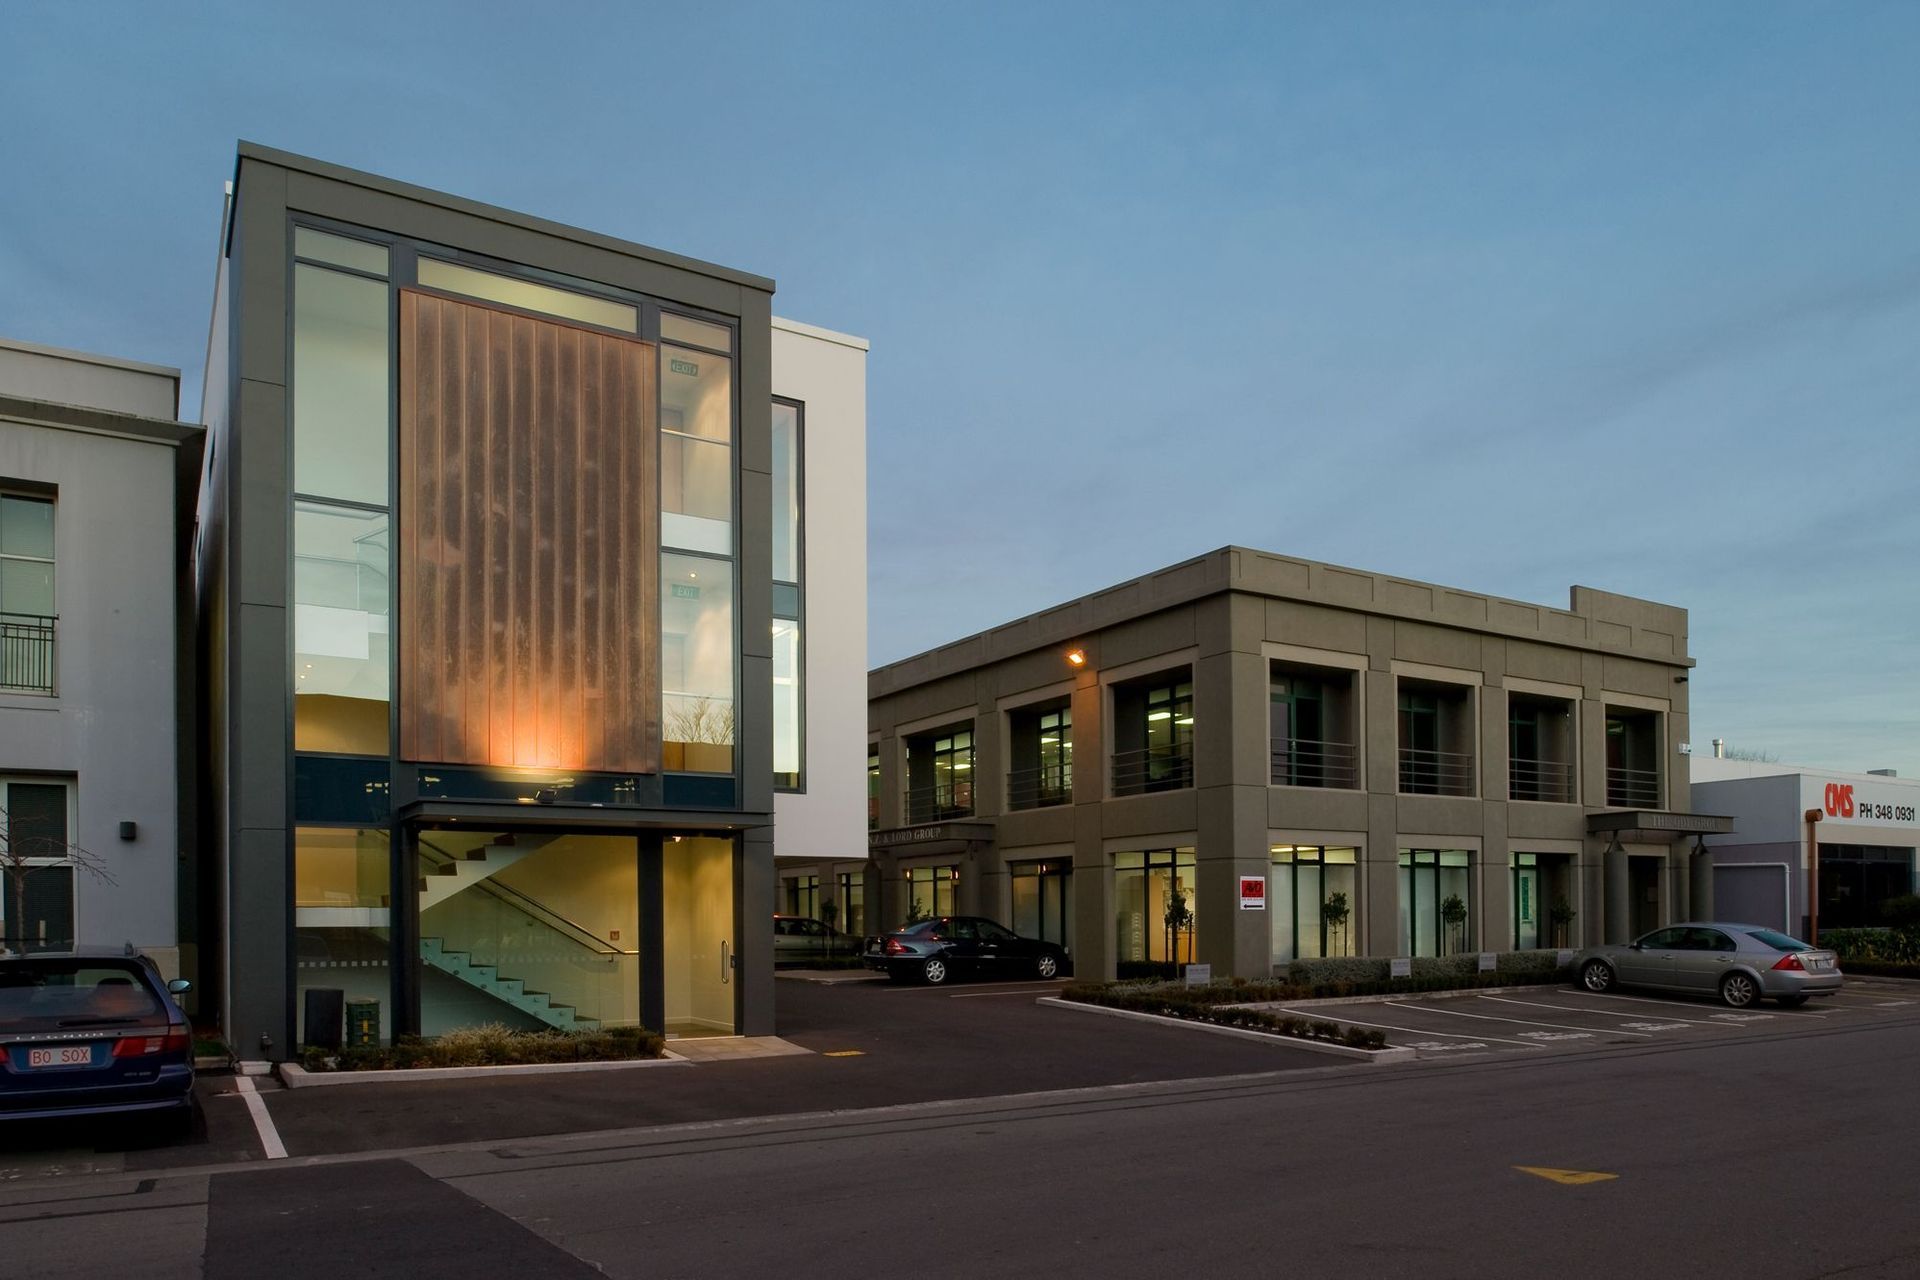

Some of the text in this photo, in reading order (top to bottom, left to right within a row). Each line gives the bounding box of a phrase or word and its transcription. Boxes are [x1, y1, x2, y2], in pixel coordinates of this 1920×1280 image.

[1825, 783, 1854, 818] CMS
[1860, 803, 1915, 821] PH 348 0931
[914, 827, 941, 840] GROUP
[61, 1049, 89, 1063] SOX
